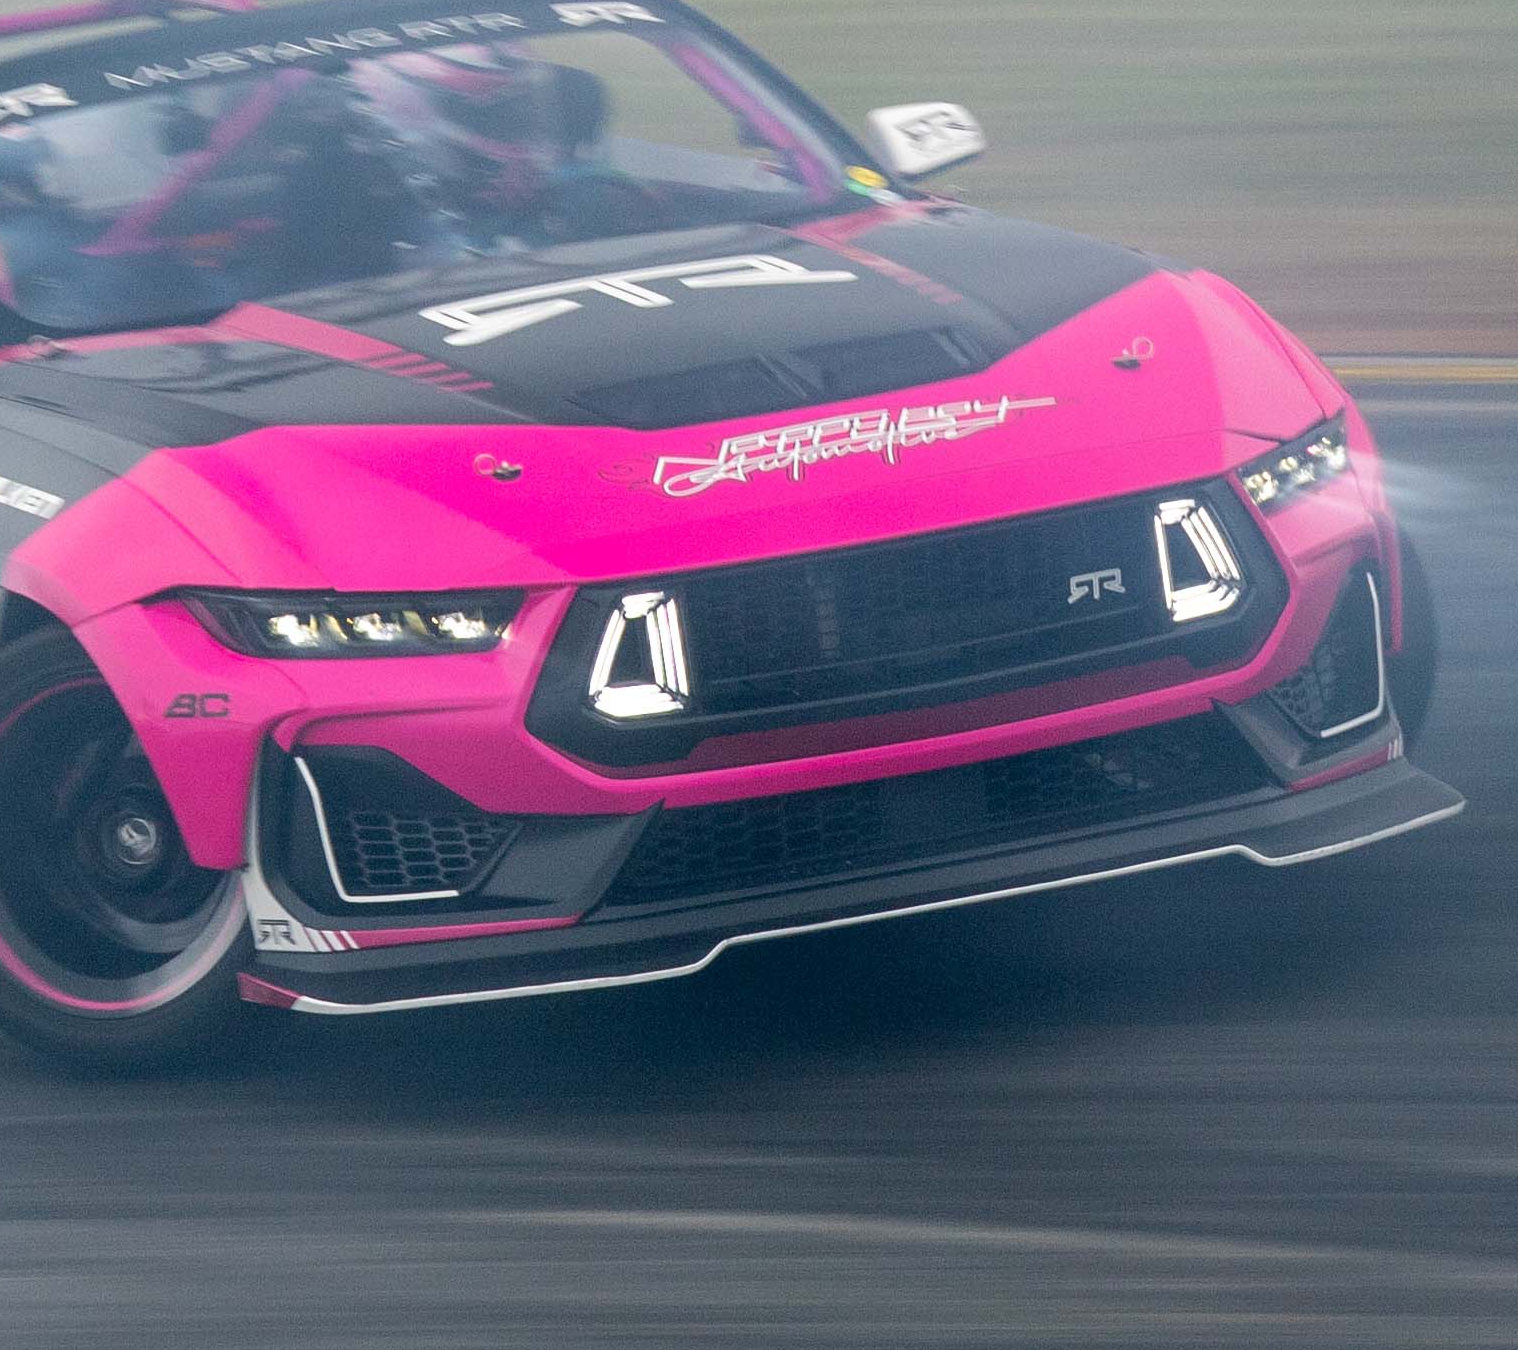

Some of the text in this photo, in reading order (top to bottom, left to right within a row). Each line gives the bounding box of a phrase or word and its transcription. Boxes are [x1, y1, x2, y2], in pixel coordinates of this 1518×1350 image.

[103, 11, 530, 90] MUSTANG RTR
[1067, 568, 1126, 604] RTR
[164, 693, 231, 719] BC
